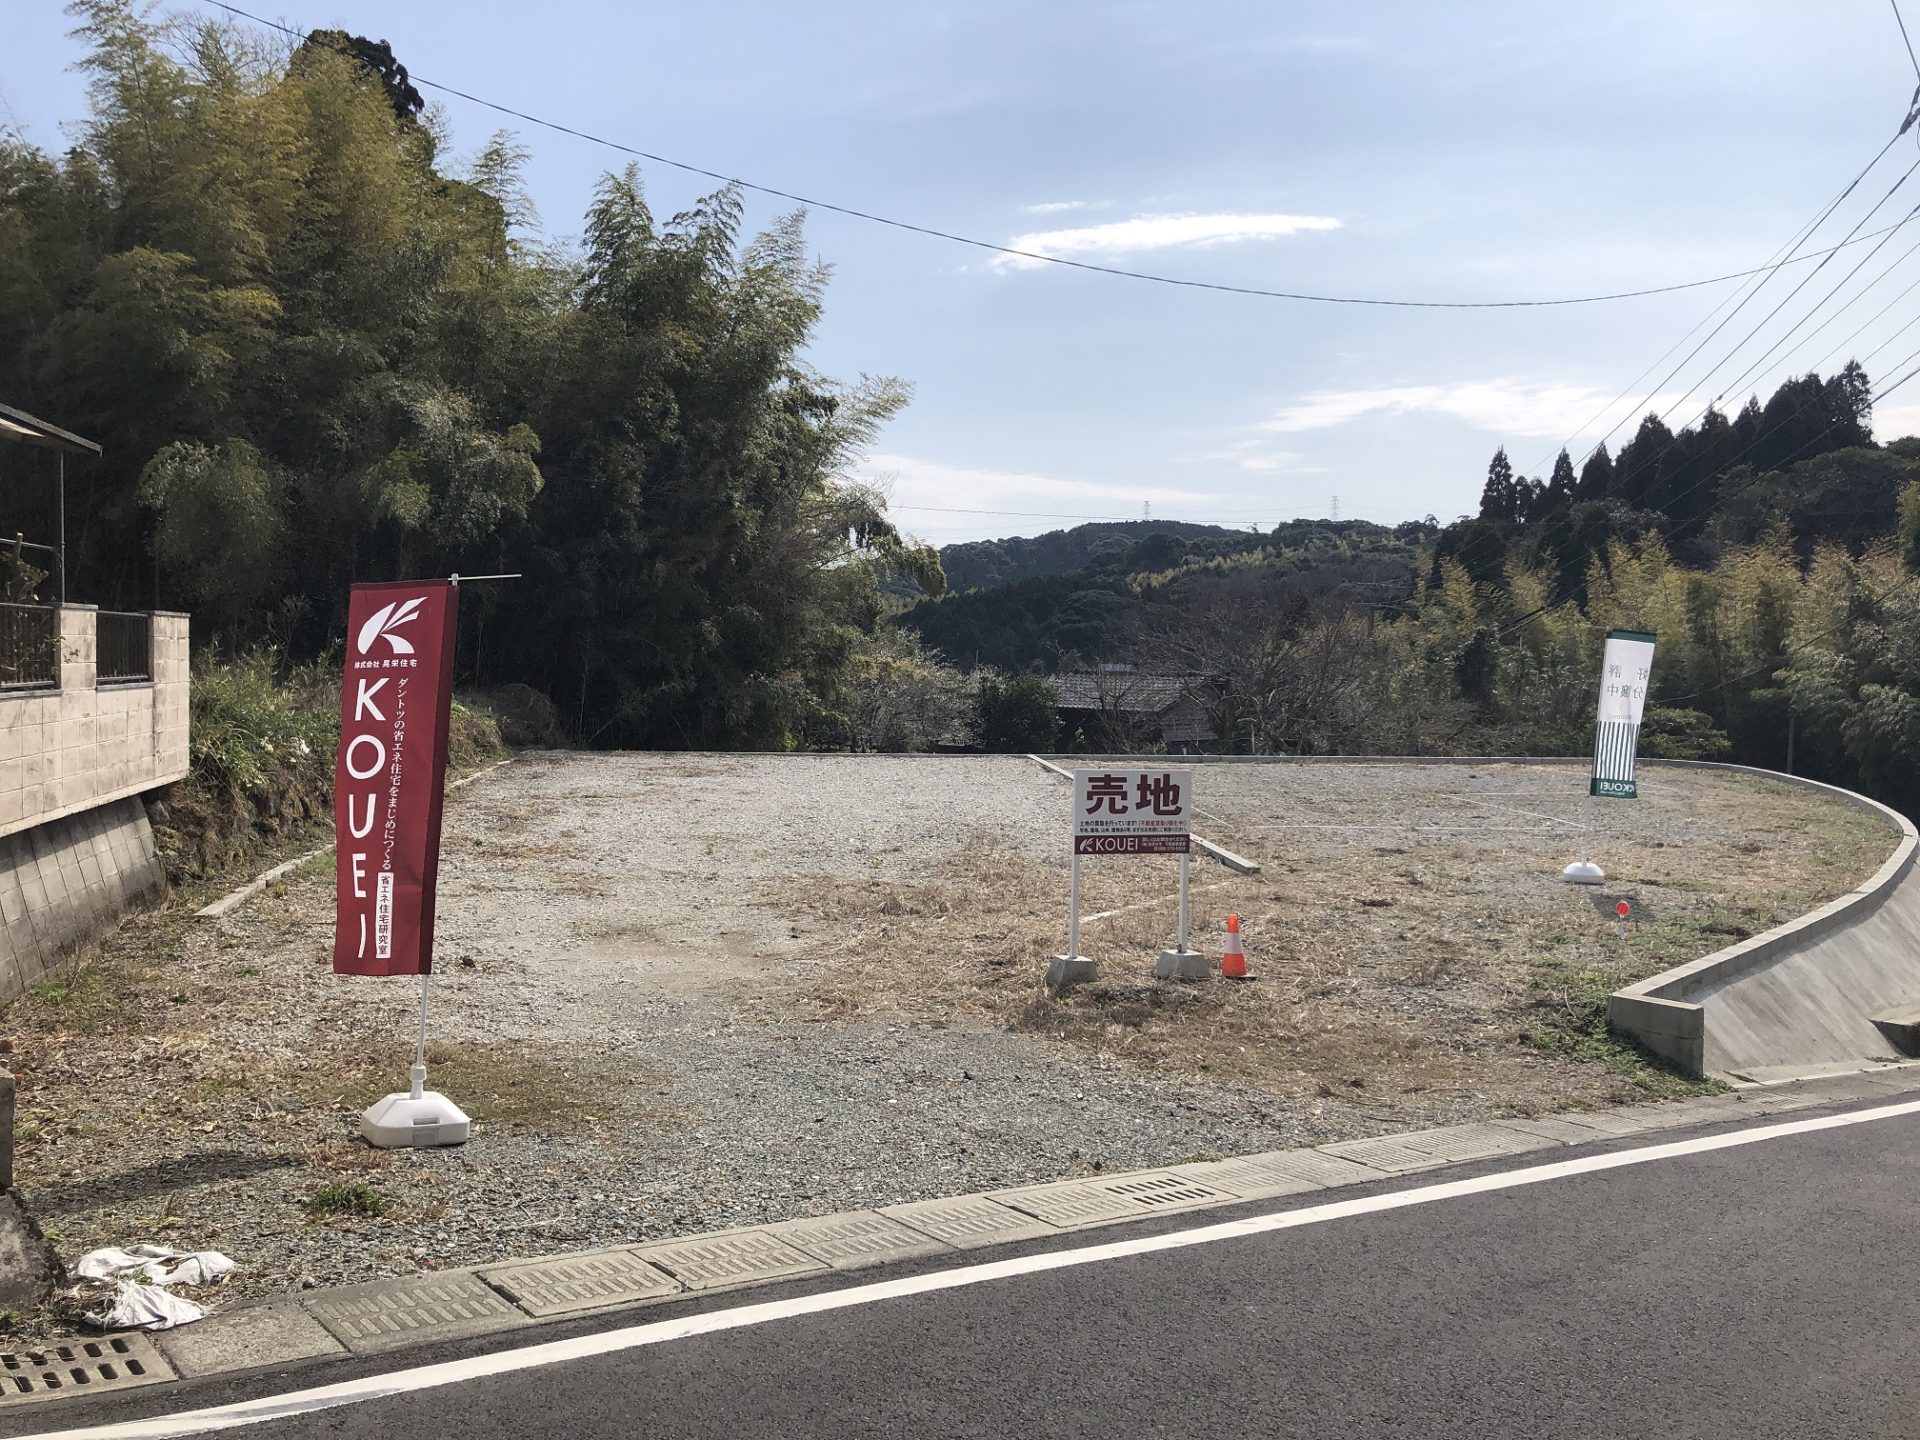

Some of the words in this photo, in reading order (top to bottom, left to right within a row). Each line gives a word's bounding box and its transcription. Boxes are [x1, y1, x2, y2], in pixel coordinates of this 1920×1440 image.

[354, 660, 380, 669] 株式会社
[382, 677, 409, 870] ダントツの省エネ住宅をまじめにつくる
[1086, 774, 1183, 815] 売地
[346, 677, 390, 959] KOUEI
[1096, 838, 1138, 851] KOUEI
[378, 874, 391, 955] 省エネ住宅研究室
